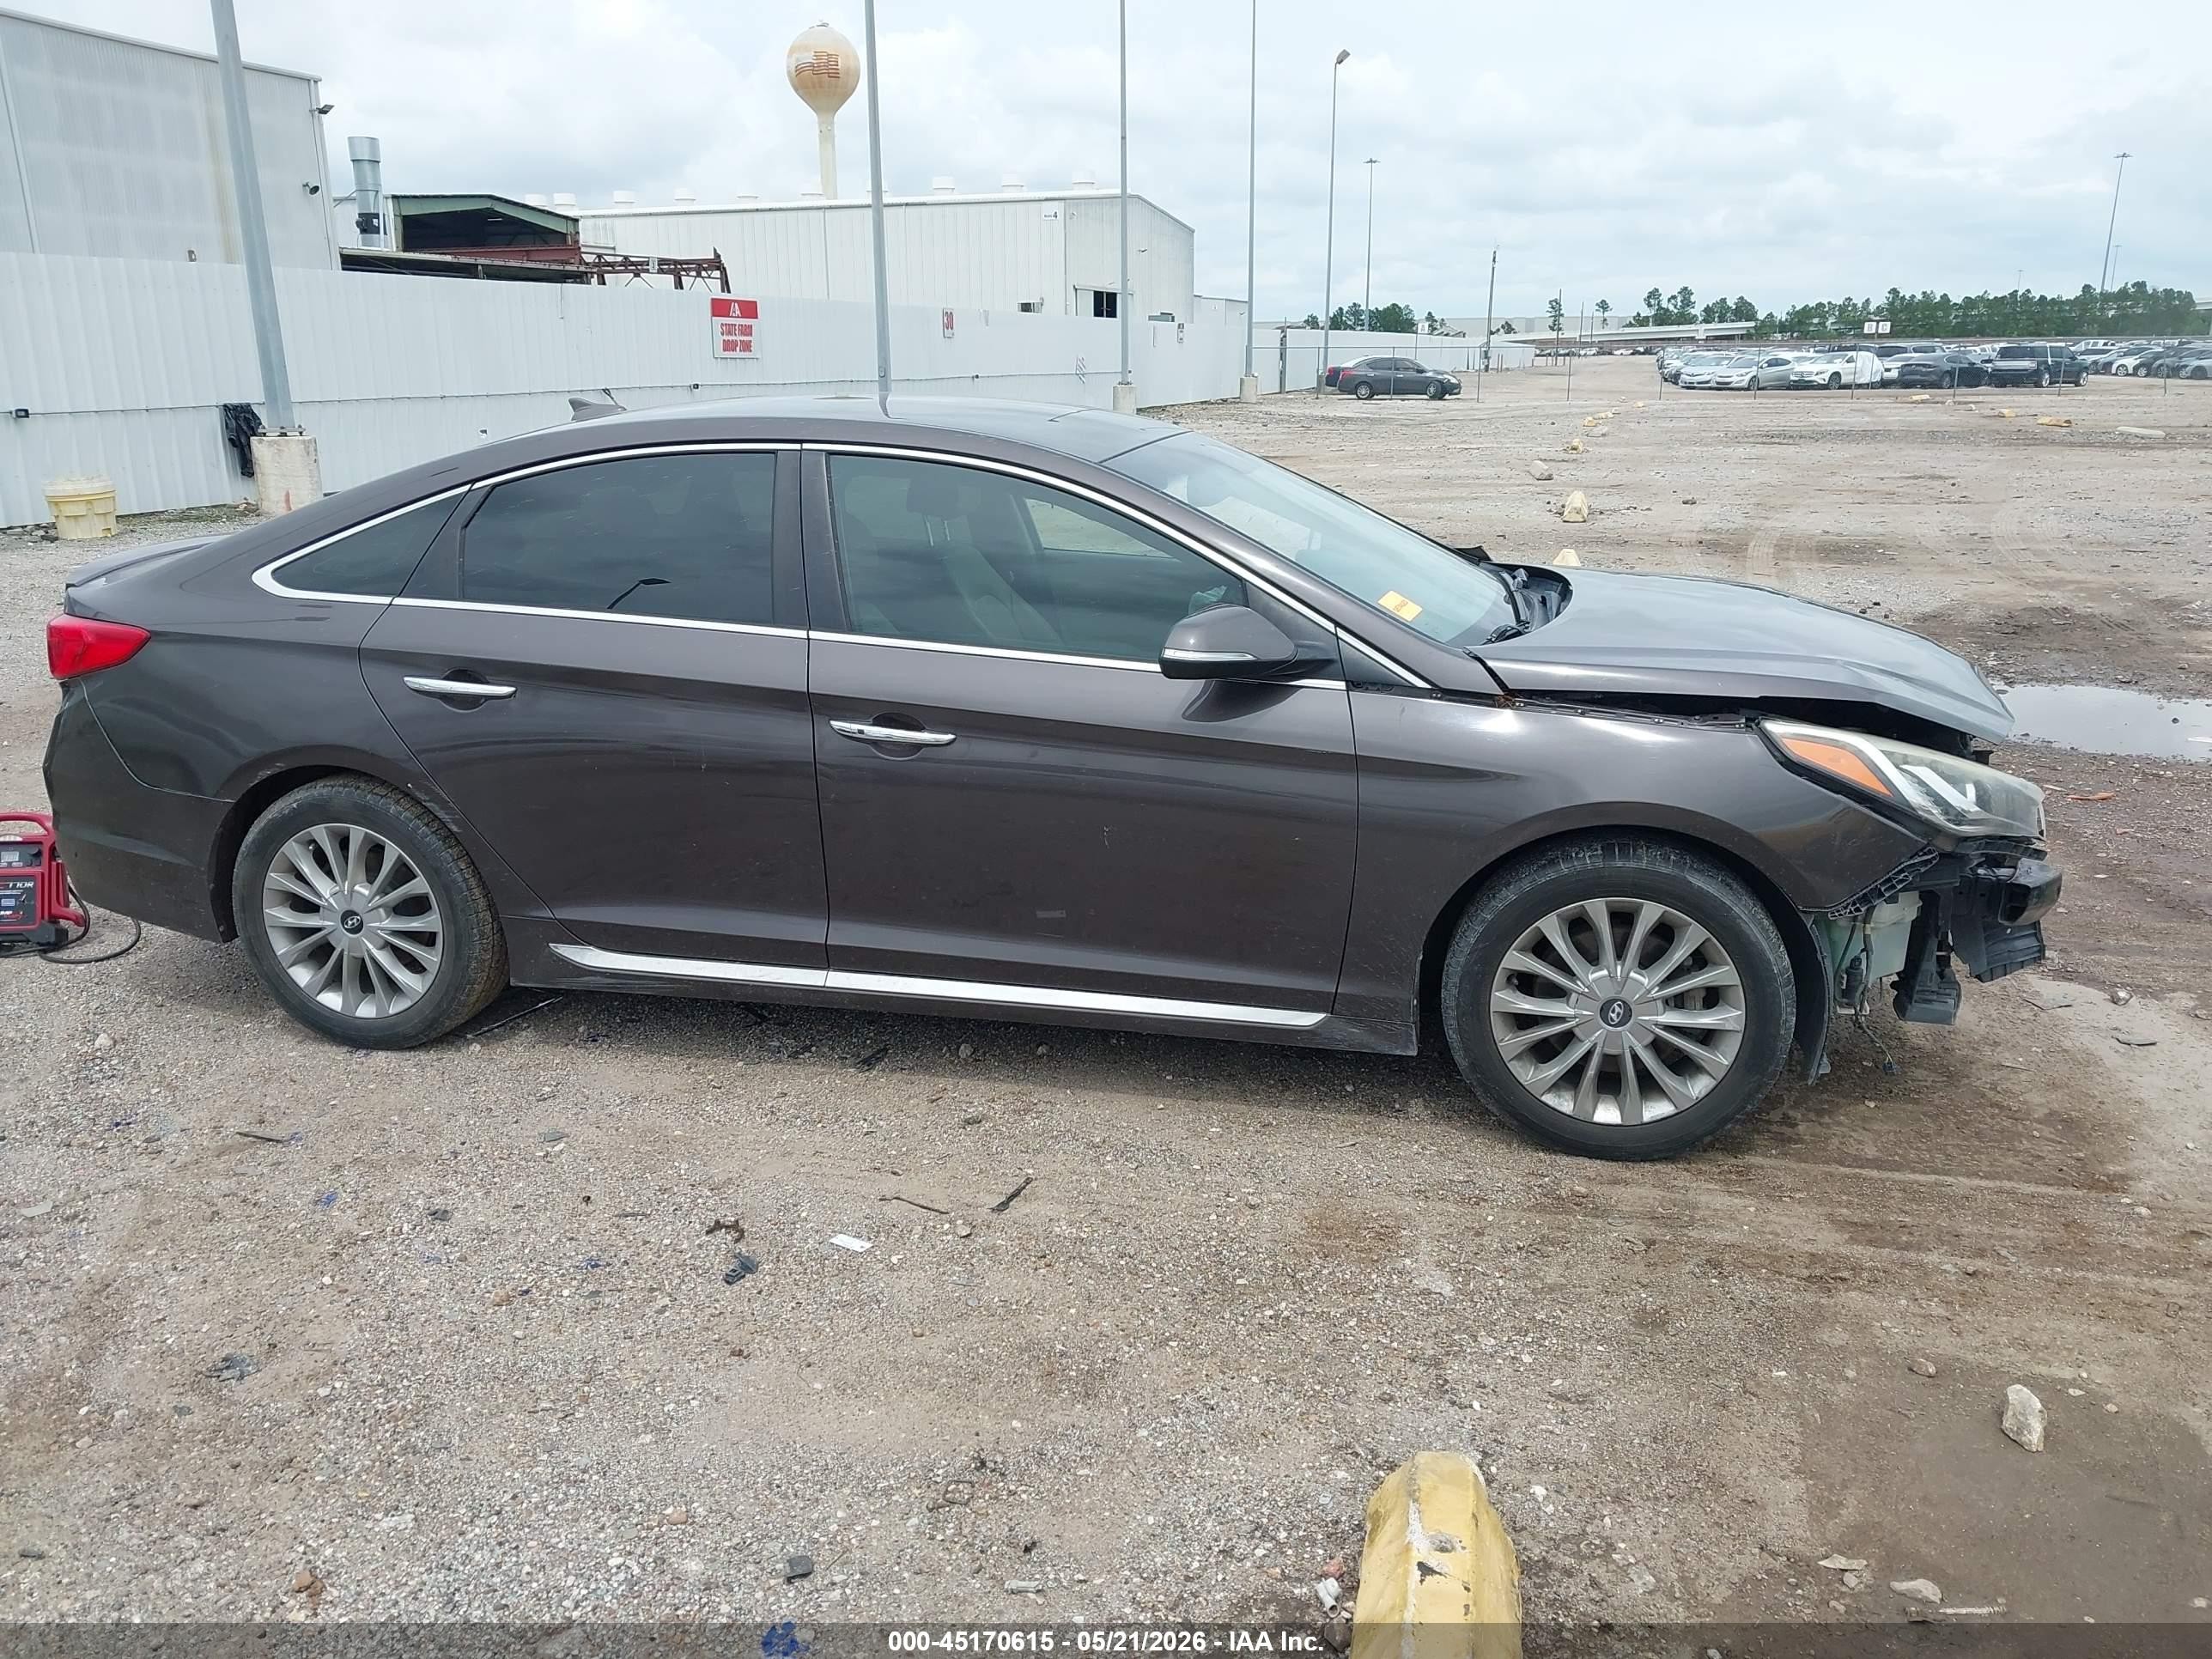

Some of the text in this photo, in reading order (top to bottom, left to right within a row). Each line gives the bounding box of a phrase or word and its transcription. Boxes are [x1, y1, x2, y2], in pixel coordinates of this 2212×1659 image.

[945, 311, 953, 330] 30
[720, 323, 753, 338] STATE FARM
[722, 338, 752, 353] DROP ZONE
